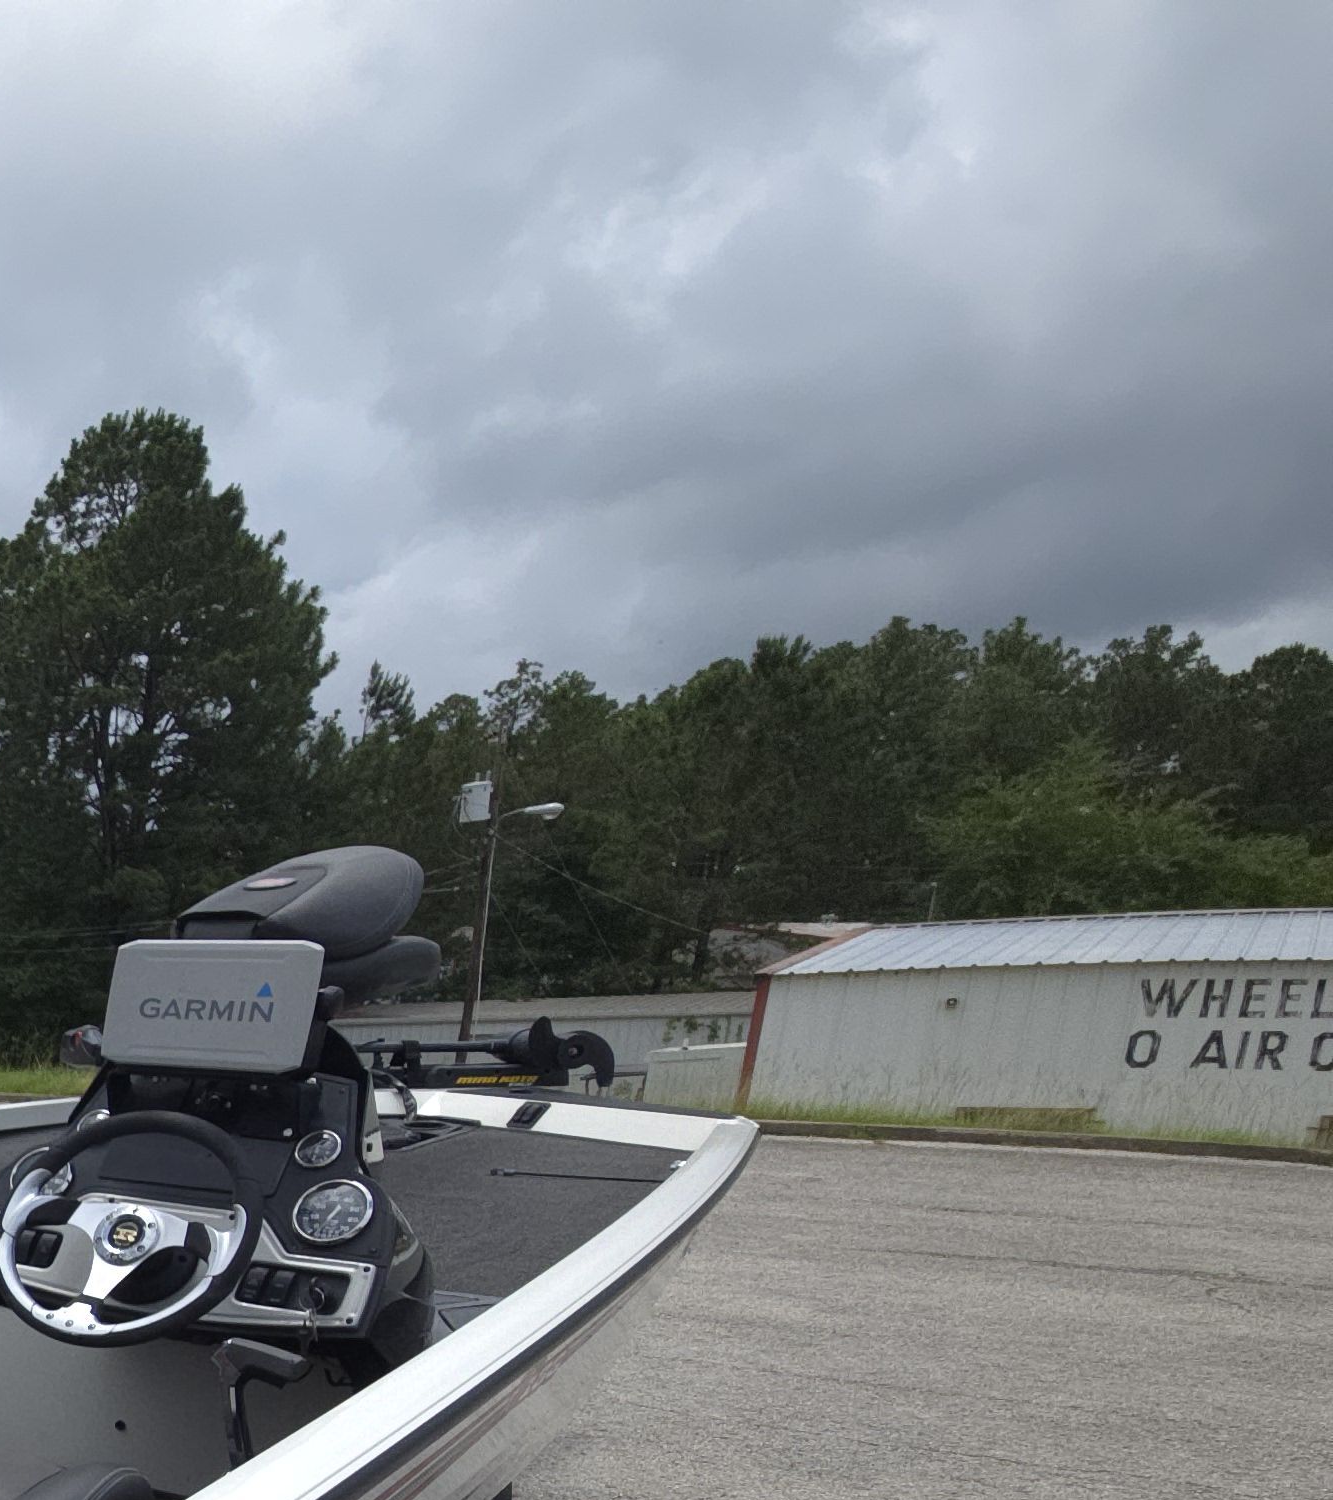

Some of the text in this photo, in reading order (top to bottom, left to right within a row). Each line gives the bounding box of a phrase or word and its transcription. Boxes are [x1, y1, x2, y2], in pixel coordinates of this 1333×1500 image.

[139, 997, 275, 1023] GARMIN
[1141, 978, 1333, 1019] WHEEL
[1189, 1029, 1289, 1071] AIR
